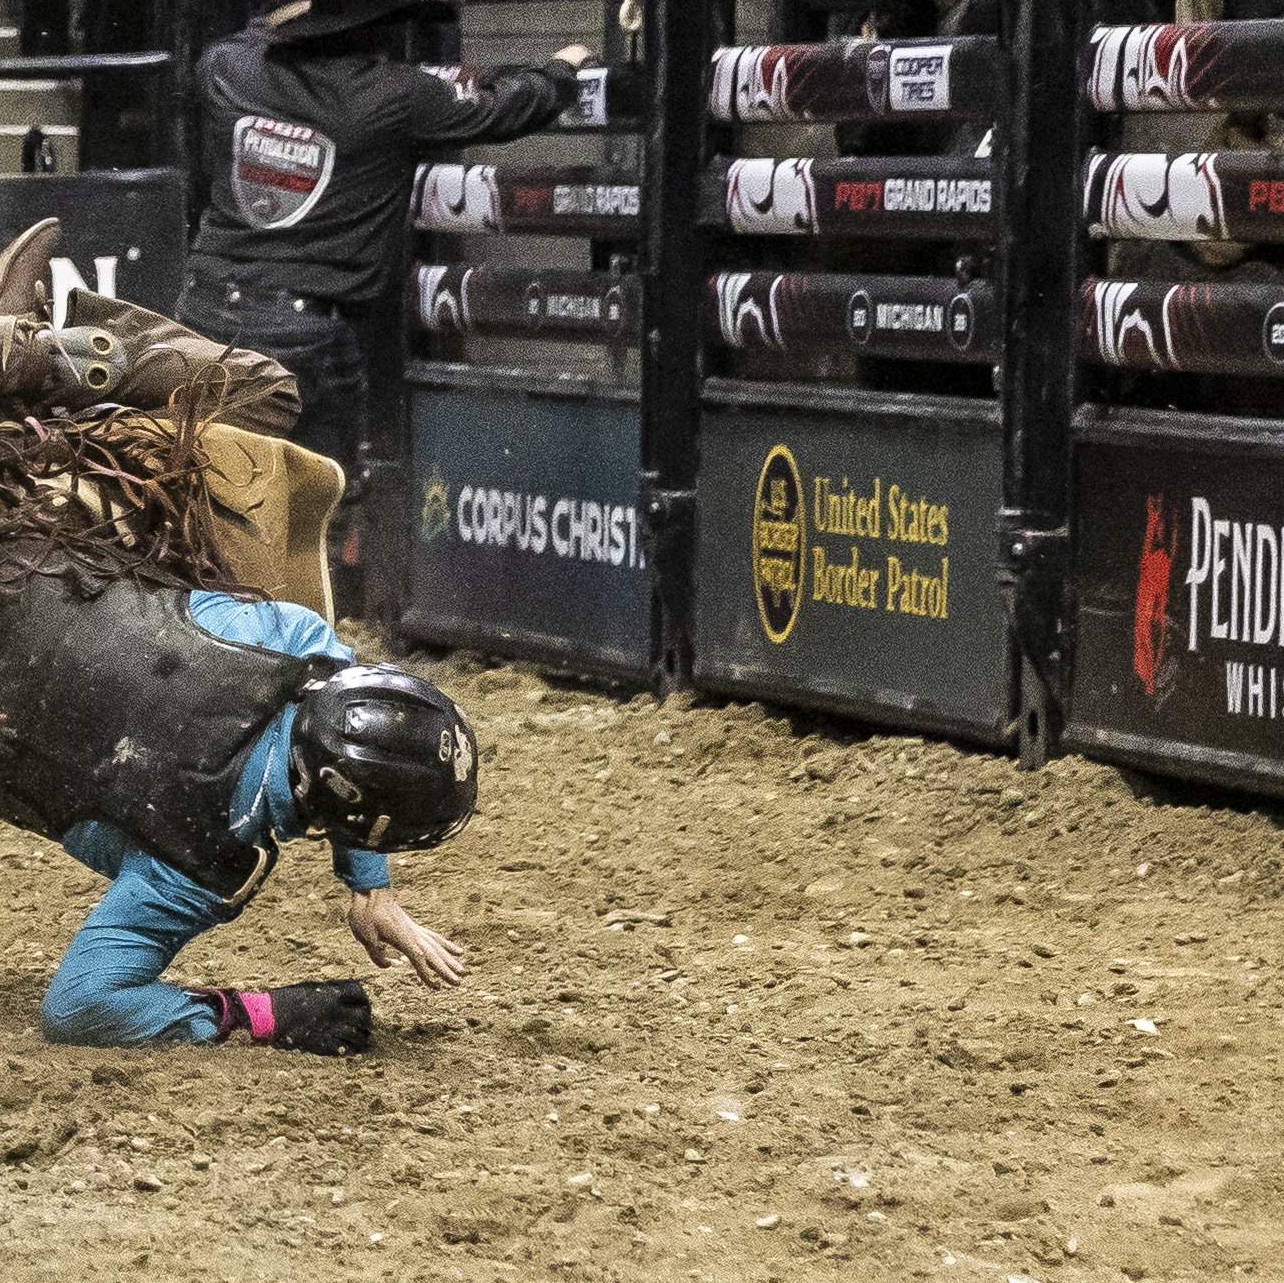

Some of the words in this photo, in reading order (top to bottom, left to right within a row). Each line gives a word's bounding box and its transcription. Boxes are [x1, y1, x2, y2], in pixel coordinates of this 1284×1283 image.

[894, 55, 945, 77] COOPER
[883, 178, 935, 212] GRAND
[936, 179, 992, 214] RAPIDS
[457, 484, 549, 555] CORPUS
[551, 497, 646, 570] CHRIST
[812, 475, 882, 539] United
[886, 483, 949, 546] States
[811, 545, 881, 609] Border
[885, 556, 949, 619] Patrol
[1225, 660, 1284, 720] WHI
